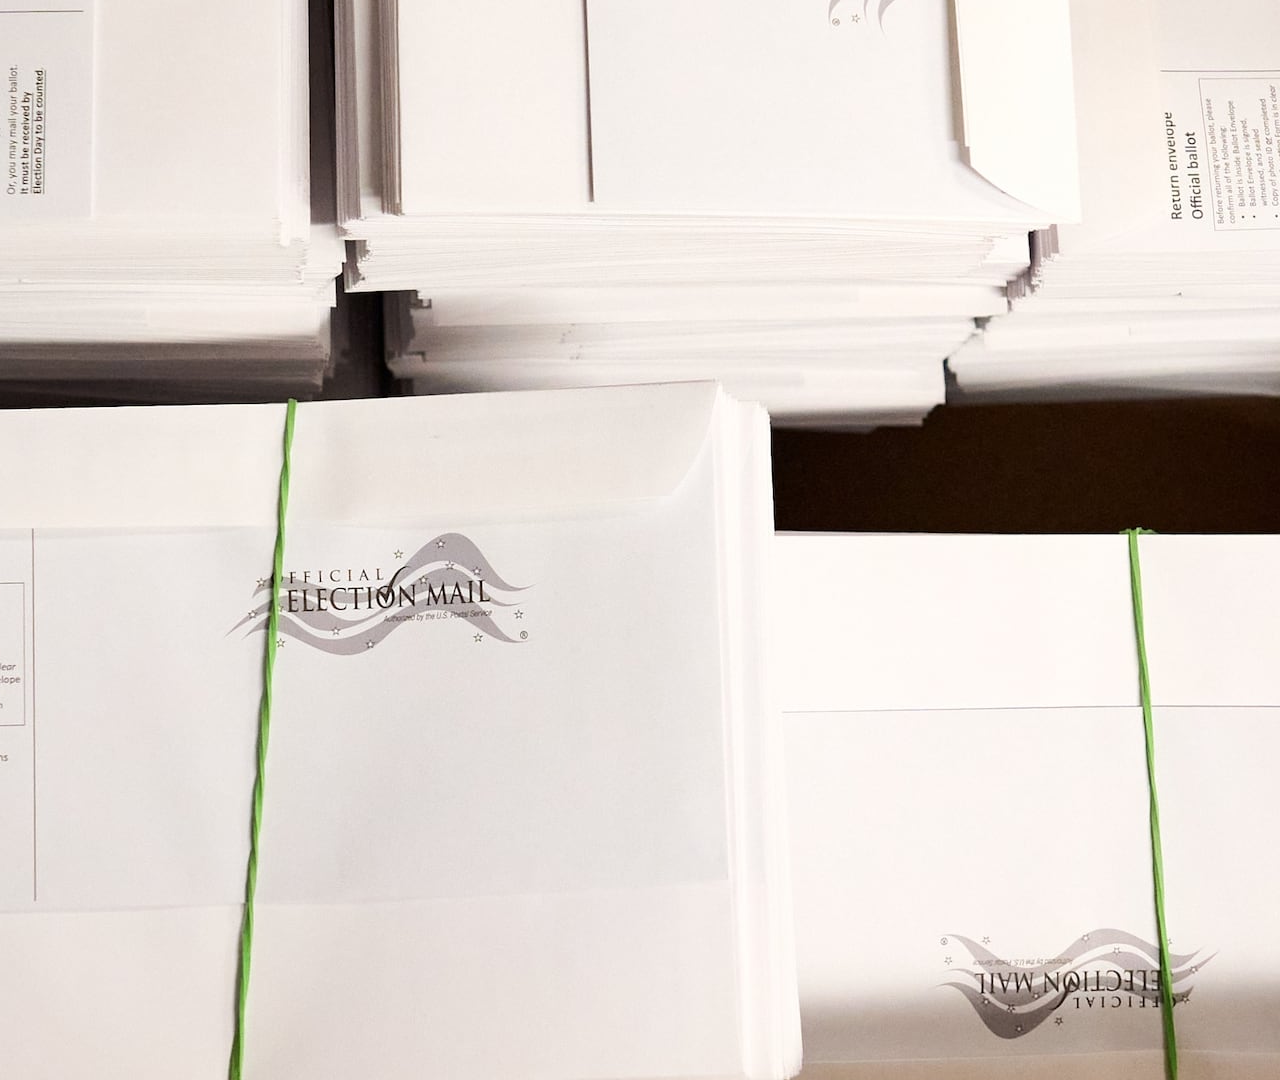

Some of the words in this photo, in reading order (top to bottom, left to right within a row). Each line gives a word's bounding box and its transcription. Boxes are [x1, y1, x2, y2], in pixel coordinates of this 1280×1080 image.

[1184, 131, 1199, 169] ballot
[1187, 172, 1204, 219] Official
[287, 585, 417, 613] ELECTION
[426, 580, 491, 606] MAIL
[974, 972, 1034, 995] MAIL
[1043, 970, 1161, 993] ELECTION
